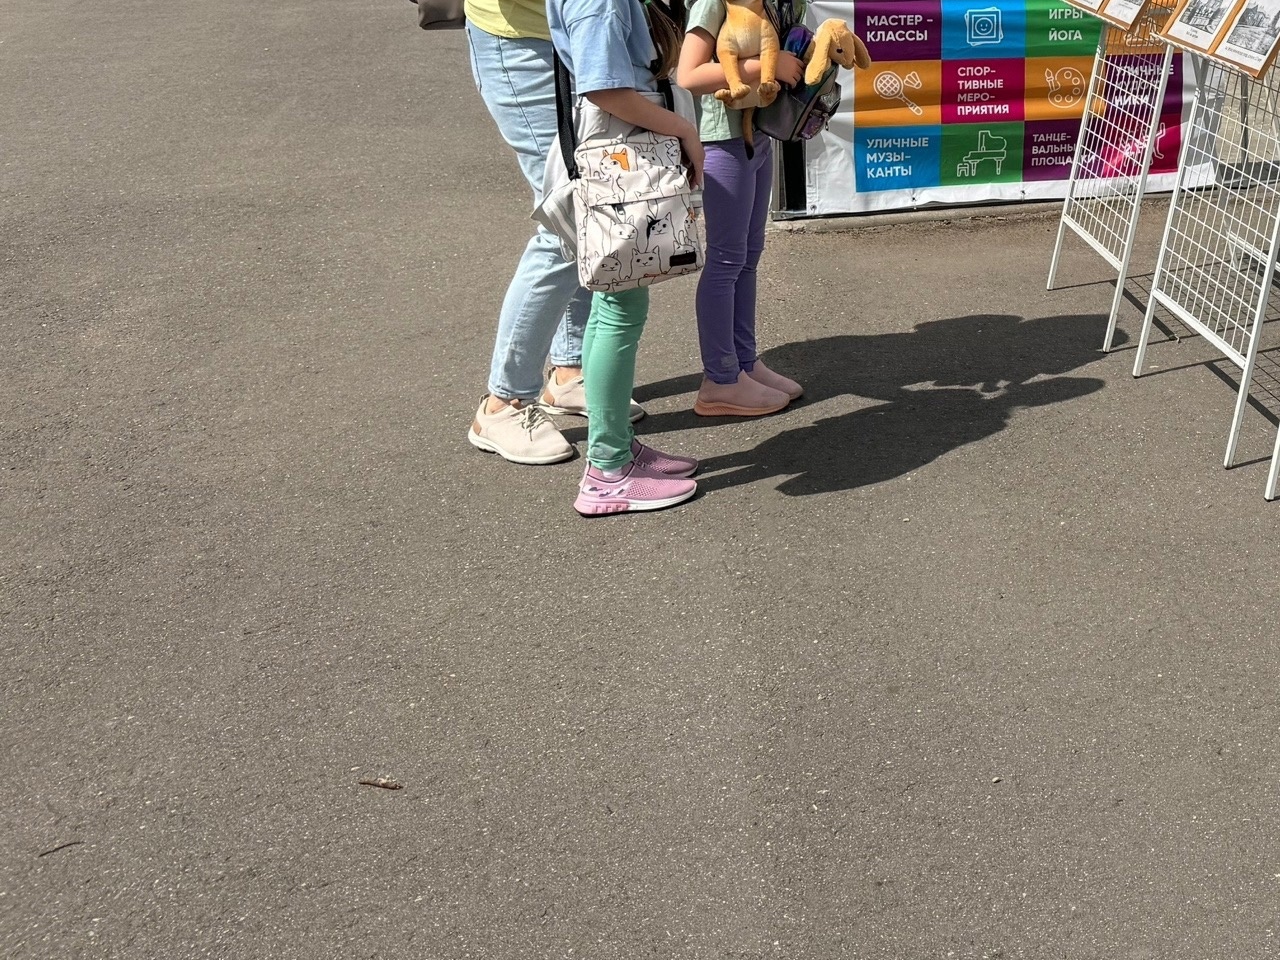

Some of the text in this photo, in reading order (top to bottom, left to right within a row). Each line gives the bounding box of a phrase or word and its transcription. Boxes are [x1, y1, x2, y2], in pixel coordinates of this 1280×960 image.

[1048, 7, 1083, 20] ИГРЫ
[866, 14, 924, 27] МАСТЕР
[866, 29, 928, 42] КЛАССЫ
[1048, 27, 1083, 41] ЙОГА
[957, 66, 996, 77] СПОР-
[957, 78, 1004, 90] ТИВНЫЕ
[957, 92, 996, 102] МЕРО-
[957, 104, 1010, 116] ПРИЯТИЯ
[866, 137, 929, 149] УЛИЧНЫЕ
[1032, 132, 1072, 143] ТАНЦЕ-
[1031, 143, 1077, 155] ВАЛЬНЫ
[866, 151, 912, 164] МУЗЫ-
[1031, 154, 1096, 167] ПЛОЩАКИ
[866, 165, 912, 179] КАНТЫ
